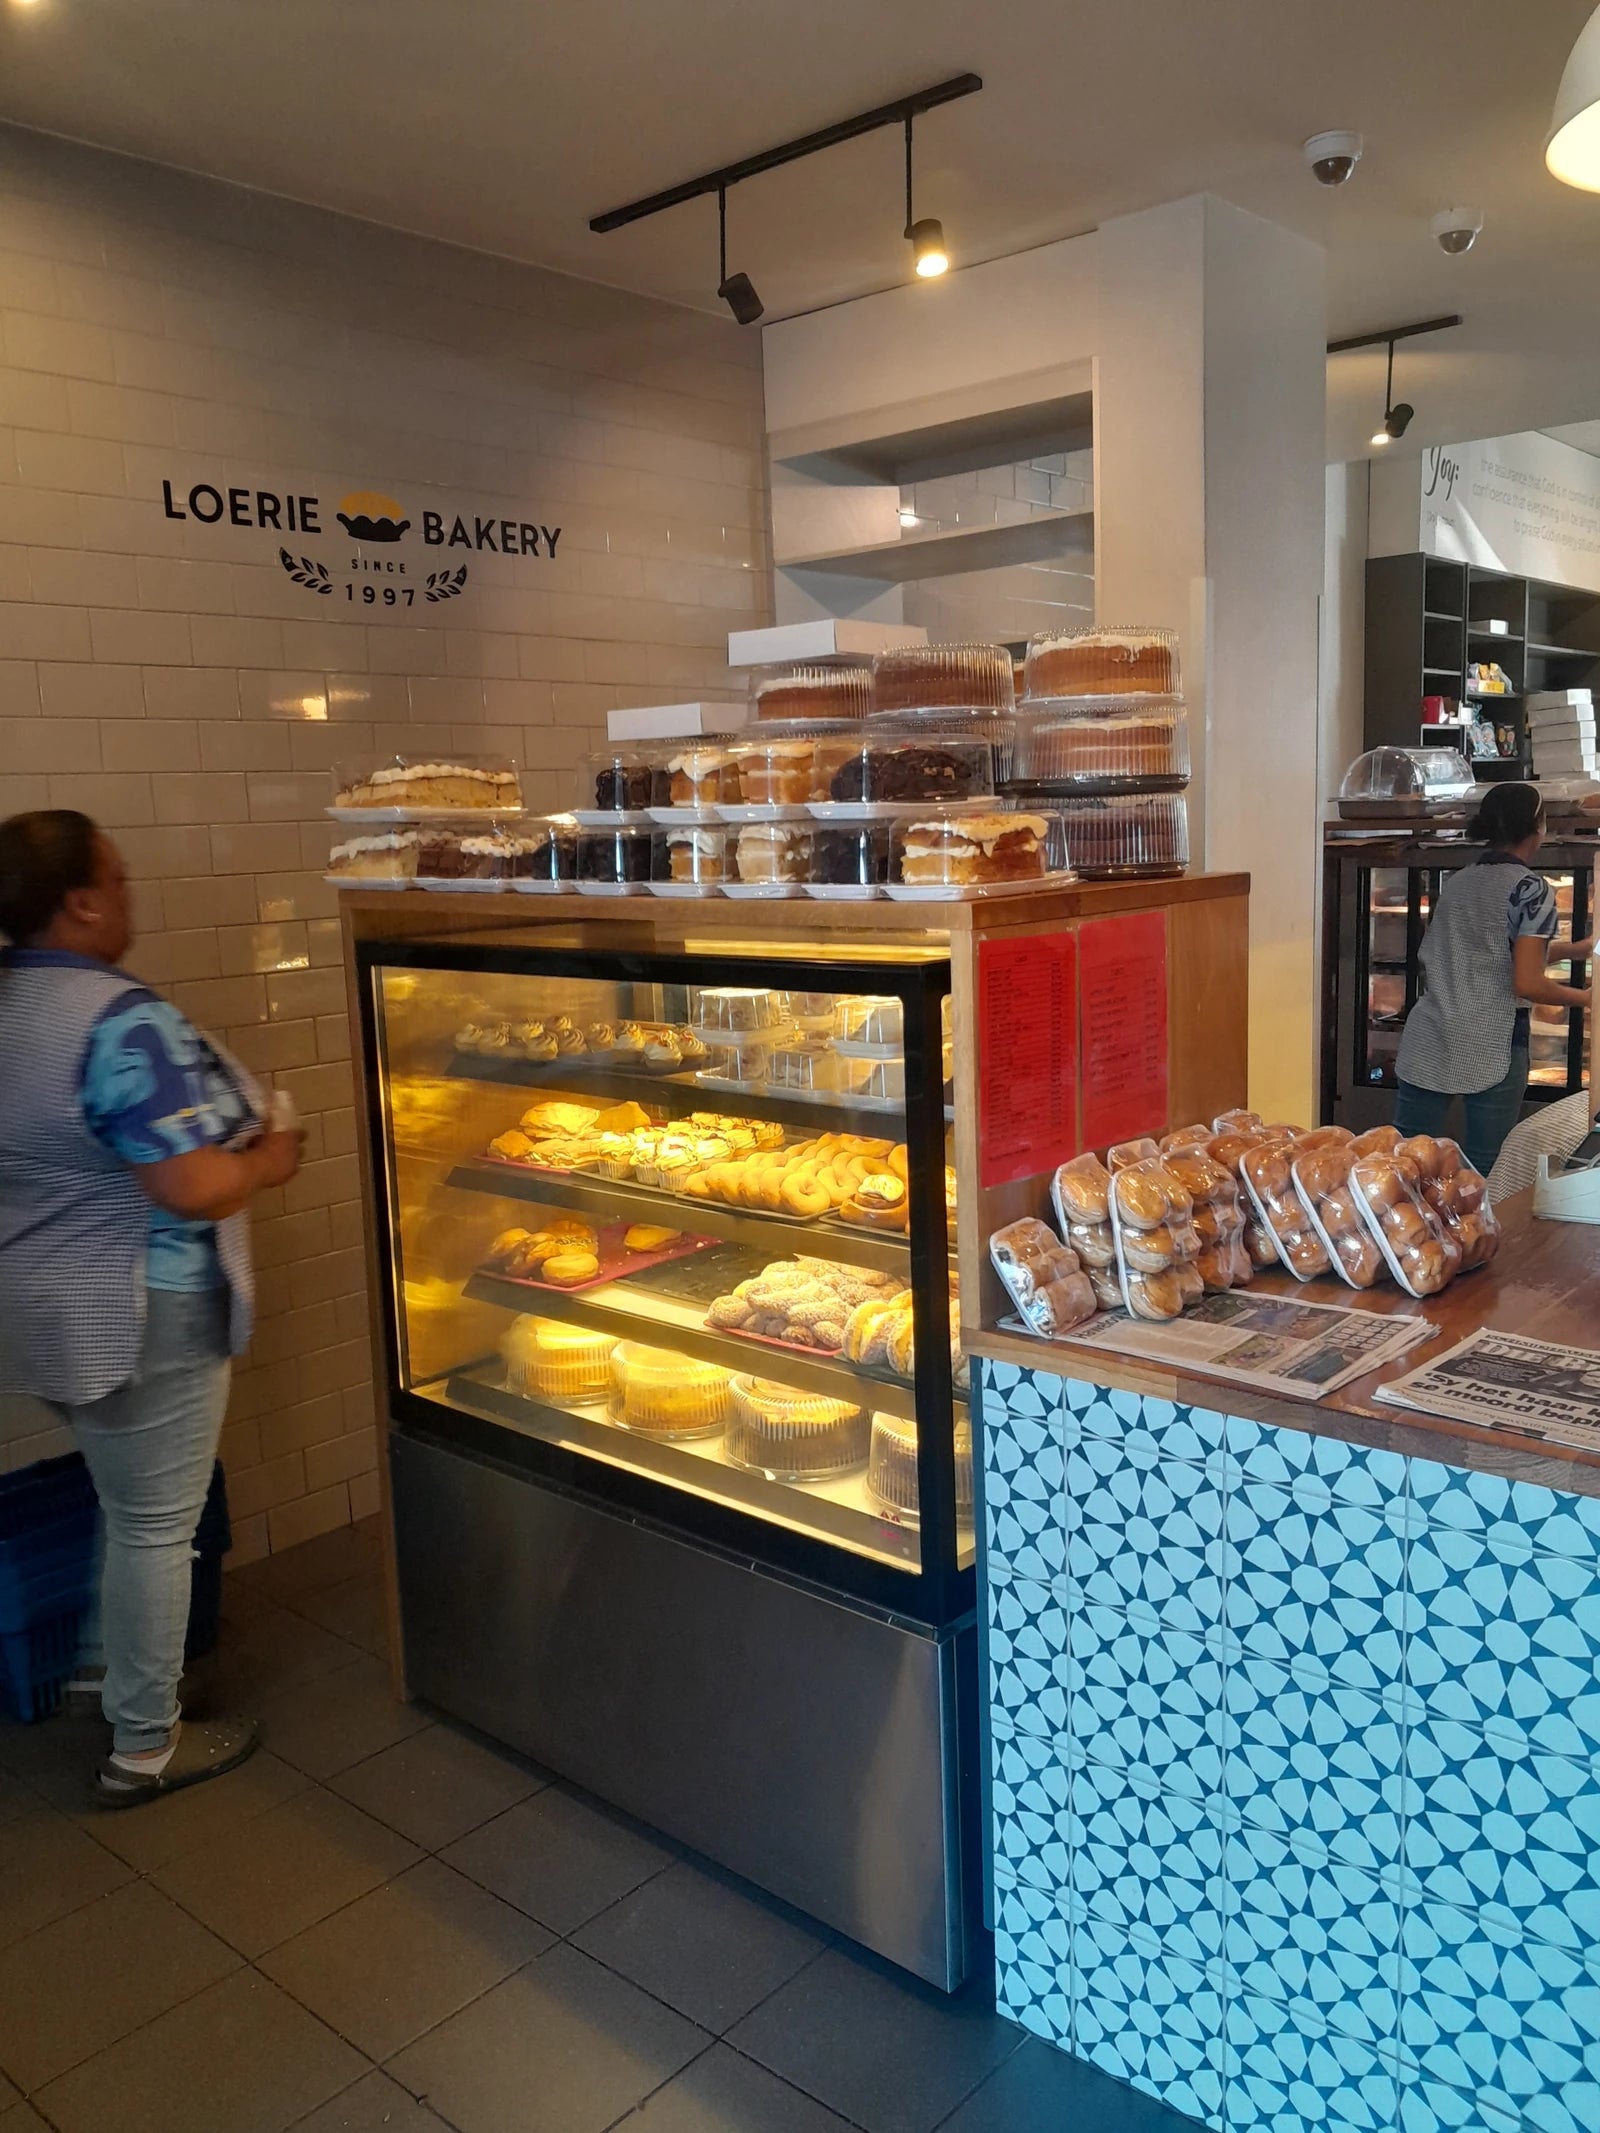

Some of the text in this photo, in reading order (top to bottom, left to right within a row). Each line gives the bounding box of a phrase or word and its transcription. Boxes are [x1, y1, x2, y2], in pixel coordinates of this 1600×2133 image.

[162, 479, 562, 559] LOERIE BAKERY
[351, 558, 407, 574] SINCE
[345, 583, 415, 606] 1997
[1411, 1381, 1439, 1391] se
[1444, 1388, 1535, 1413] moord
[1467, 1382, 1512, 1398] het
[1518, 1393, 1582, 1412] haar
